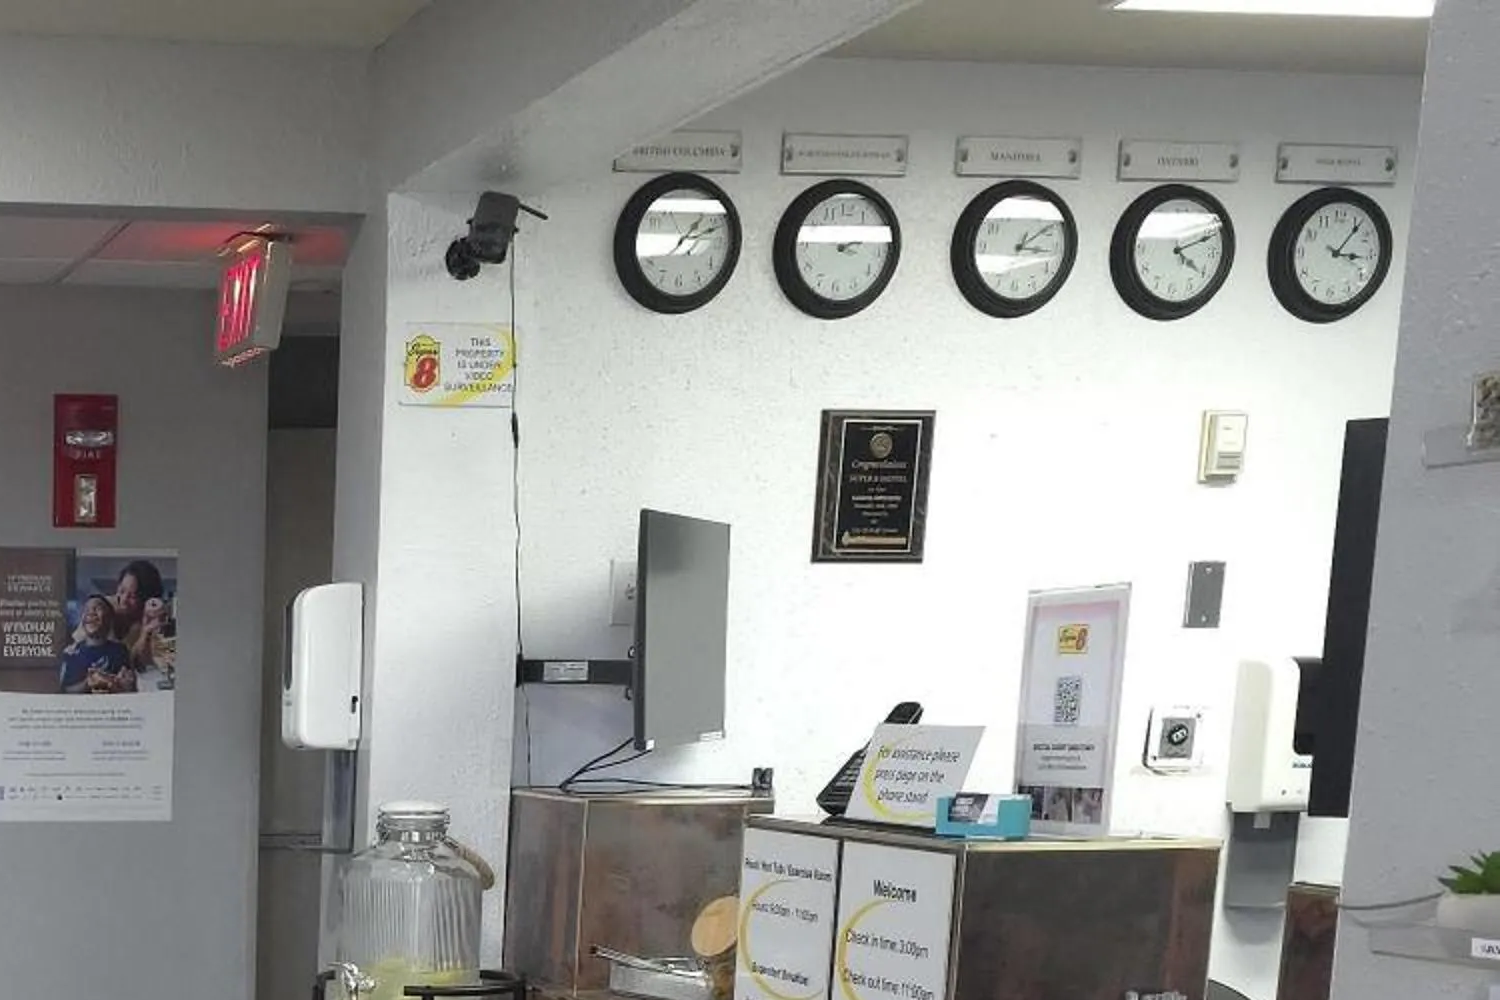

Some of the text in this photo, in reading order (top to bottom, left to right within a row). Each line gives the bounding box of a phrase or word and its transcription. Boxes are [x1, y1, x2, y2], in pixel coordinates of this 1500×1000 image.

[470, 337, 492, 347] THIS
[455, 348, 505, 358] PROPERTY
[3, 621, 54, 633] WYNDHAM
[5, 633, 53, 645] REWARDS
[873, 880, 917, 903] Welcome
[846, 928, 869, 945] Check
[899, 938, 929, 959] 3:00pm
[843, 967, 866, 986] Check
[868, 975, 880, 991] out
